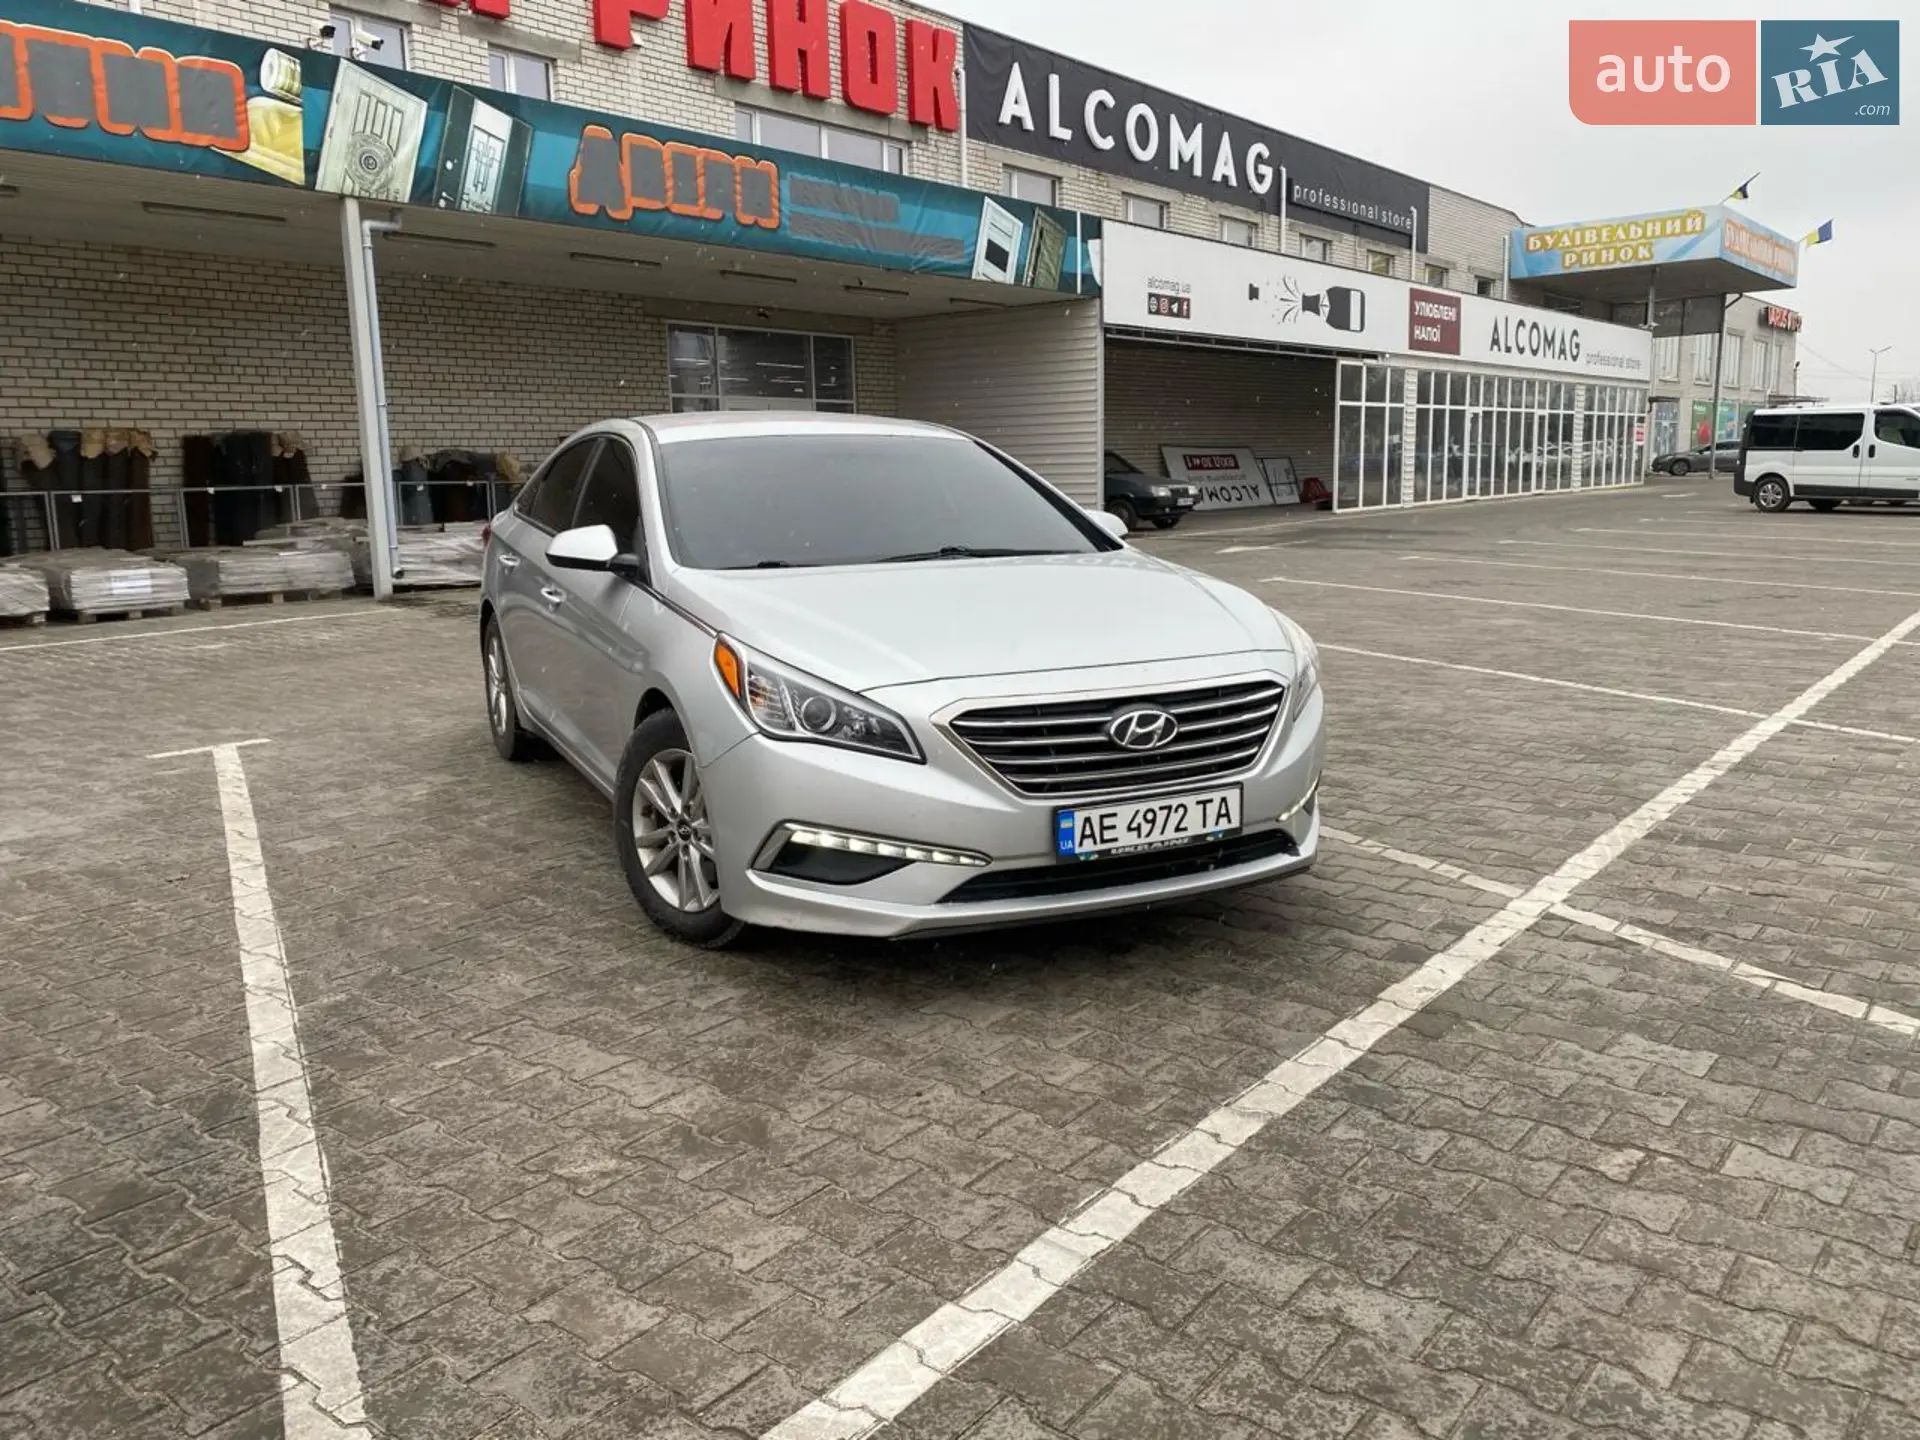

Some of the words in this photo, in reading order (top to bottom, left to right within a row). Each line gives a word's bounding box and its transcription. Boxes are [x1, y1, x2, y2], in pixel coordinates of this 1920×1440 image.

[998, 61, 1274, 195] ALCOMAG
[1293, 184, 1379, 221] professional
[1381, 209, 1412, 230] store
[1527, 213, 1706, 251] БУДІВЕЛЬНИЙ
[1563, 244, 1652, 268] РИНОК
[1489, 315, 1580, 362] ALCOMAG
[1060, 840, 1074, 850] UA
[1078, 812, 1118, 848] AE
[1126, 803, 1188, 839] 4972
[1196, 797, 1232, 829] TA
